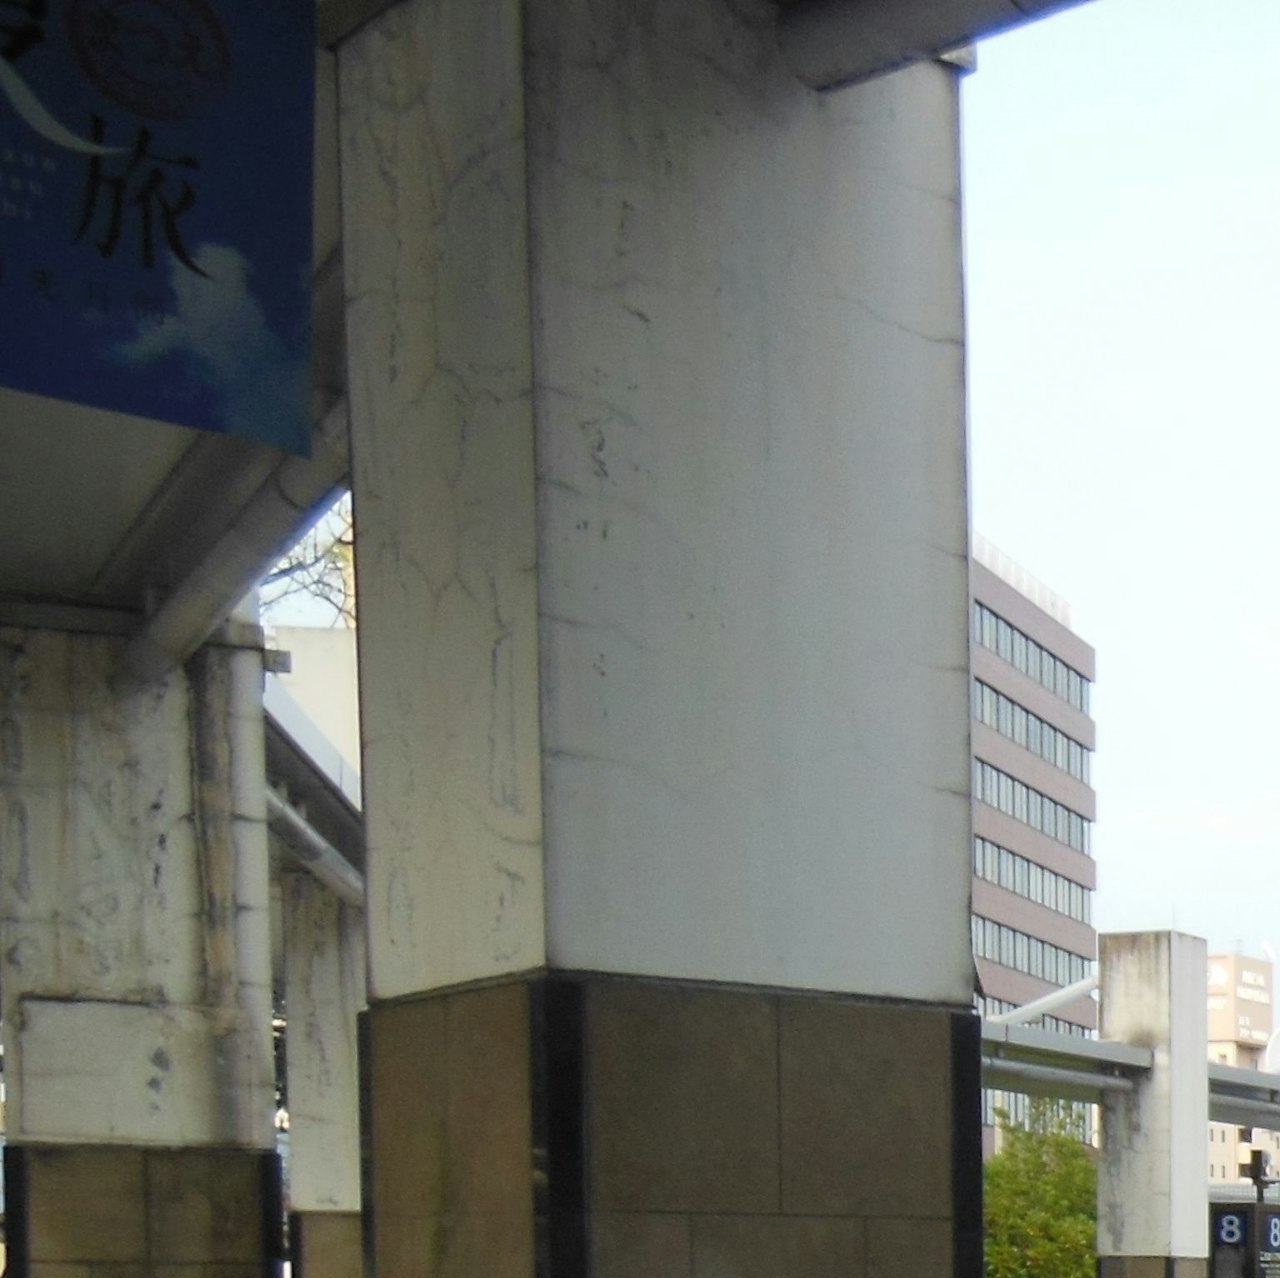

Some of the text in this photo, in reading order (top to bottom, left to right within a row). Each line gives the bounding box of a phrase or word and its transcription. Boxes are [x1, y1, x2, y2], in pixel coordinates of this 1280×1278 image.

[73, 114, 215, 282] 旅
[1221, 1214, 1241, 1243] 8
[1270, 1217, 1280, 1247] 8
